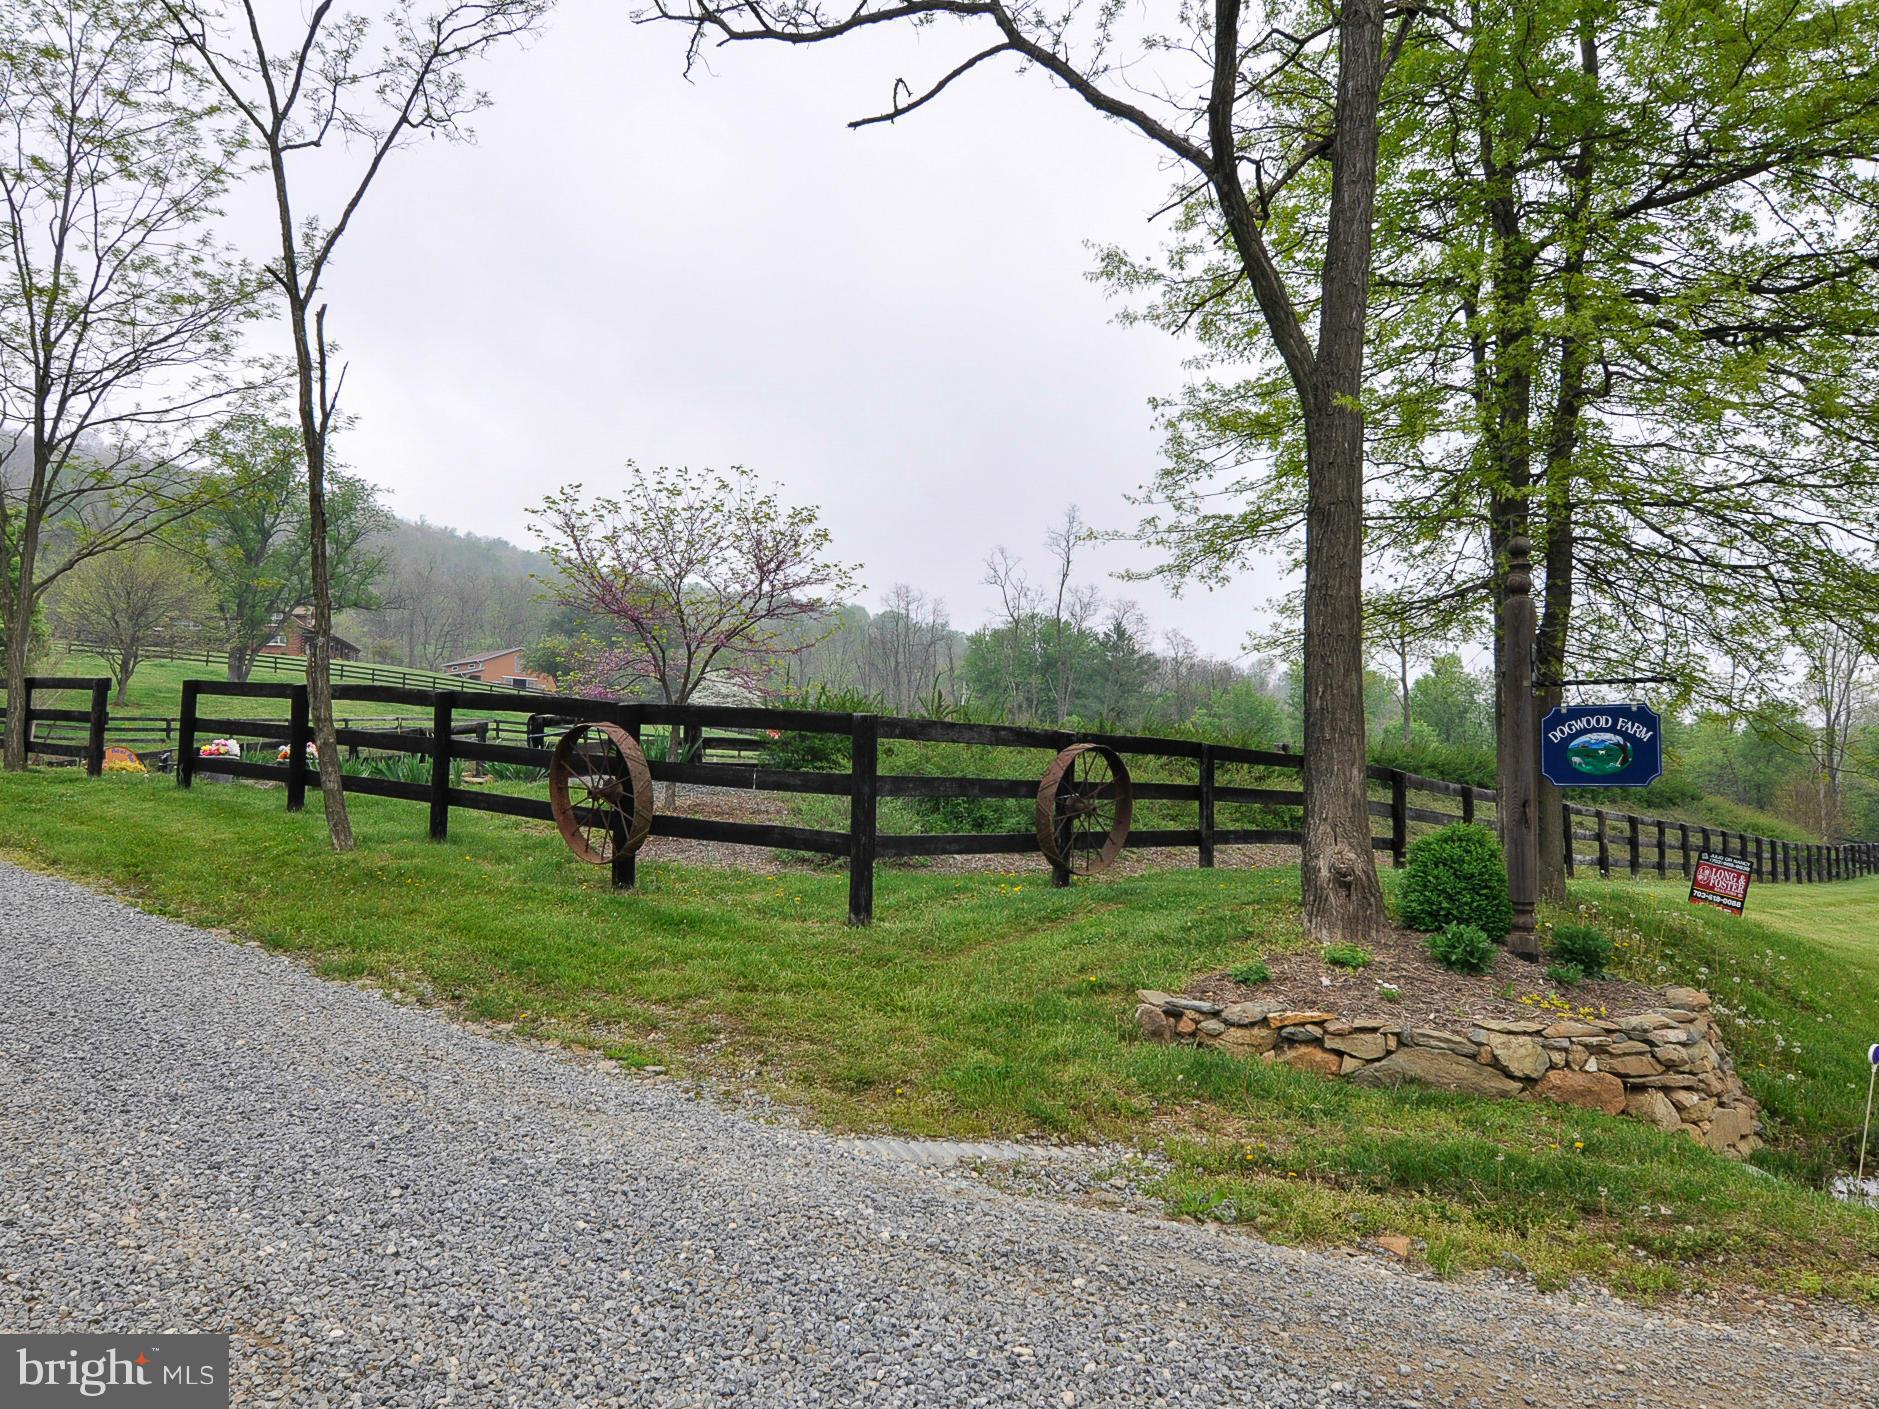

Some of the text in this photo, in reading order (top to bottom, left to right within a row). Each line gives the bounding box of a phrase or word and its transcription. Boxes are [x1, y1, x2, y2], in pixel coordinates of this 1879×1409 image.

[1548, 715, 1653, 743] DOGWOOD FARM
[1709, 875, 1745, 894] FOSTER
[1711, 868, 1746, 886] LONG &
